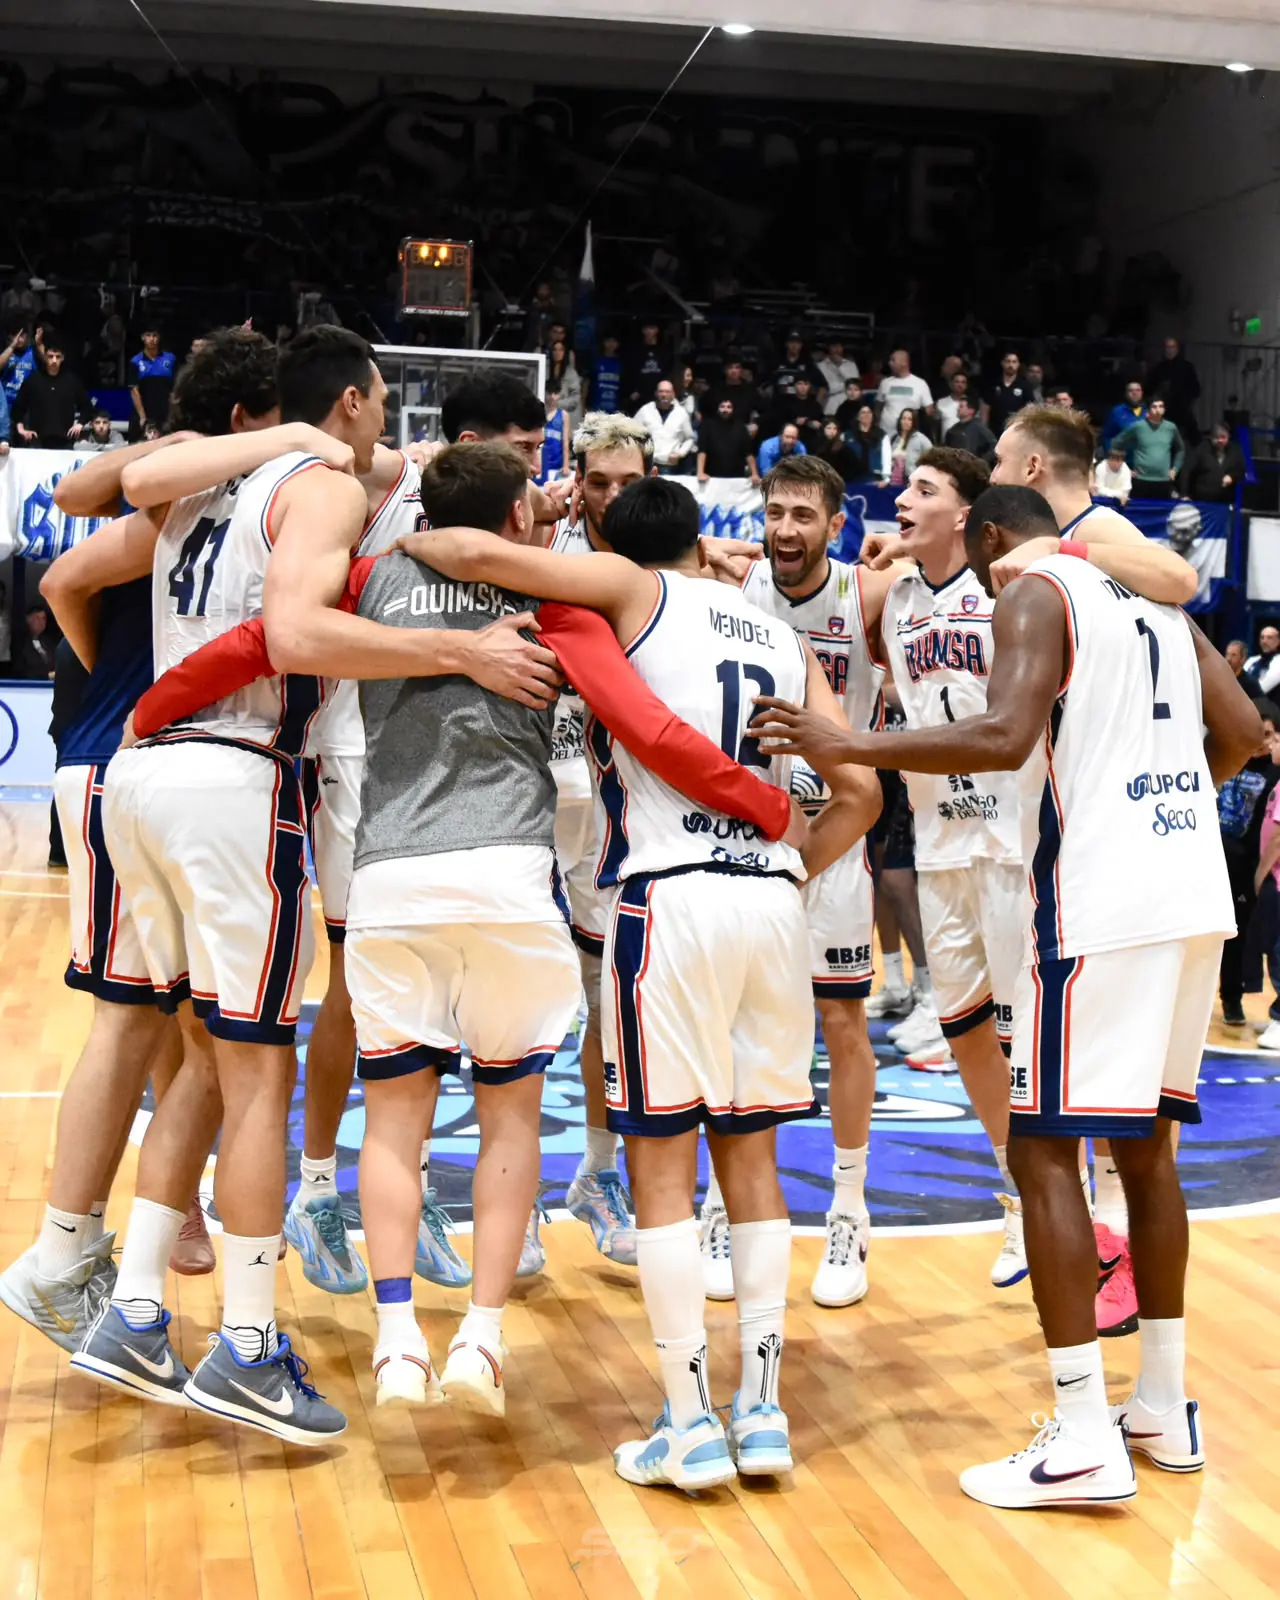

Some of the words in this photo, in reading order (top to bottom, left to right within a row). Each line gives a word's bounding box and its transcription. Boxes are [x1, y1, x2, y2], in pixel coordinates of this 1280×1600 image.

[168, 516, 232, 617] 41
[1152, 802, 1197, 837] Seco
[840, 944, 870, 964] BSE
